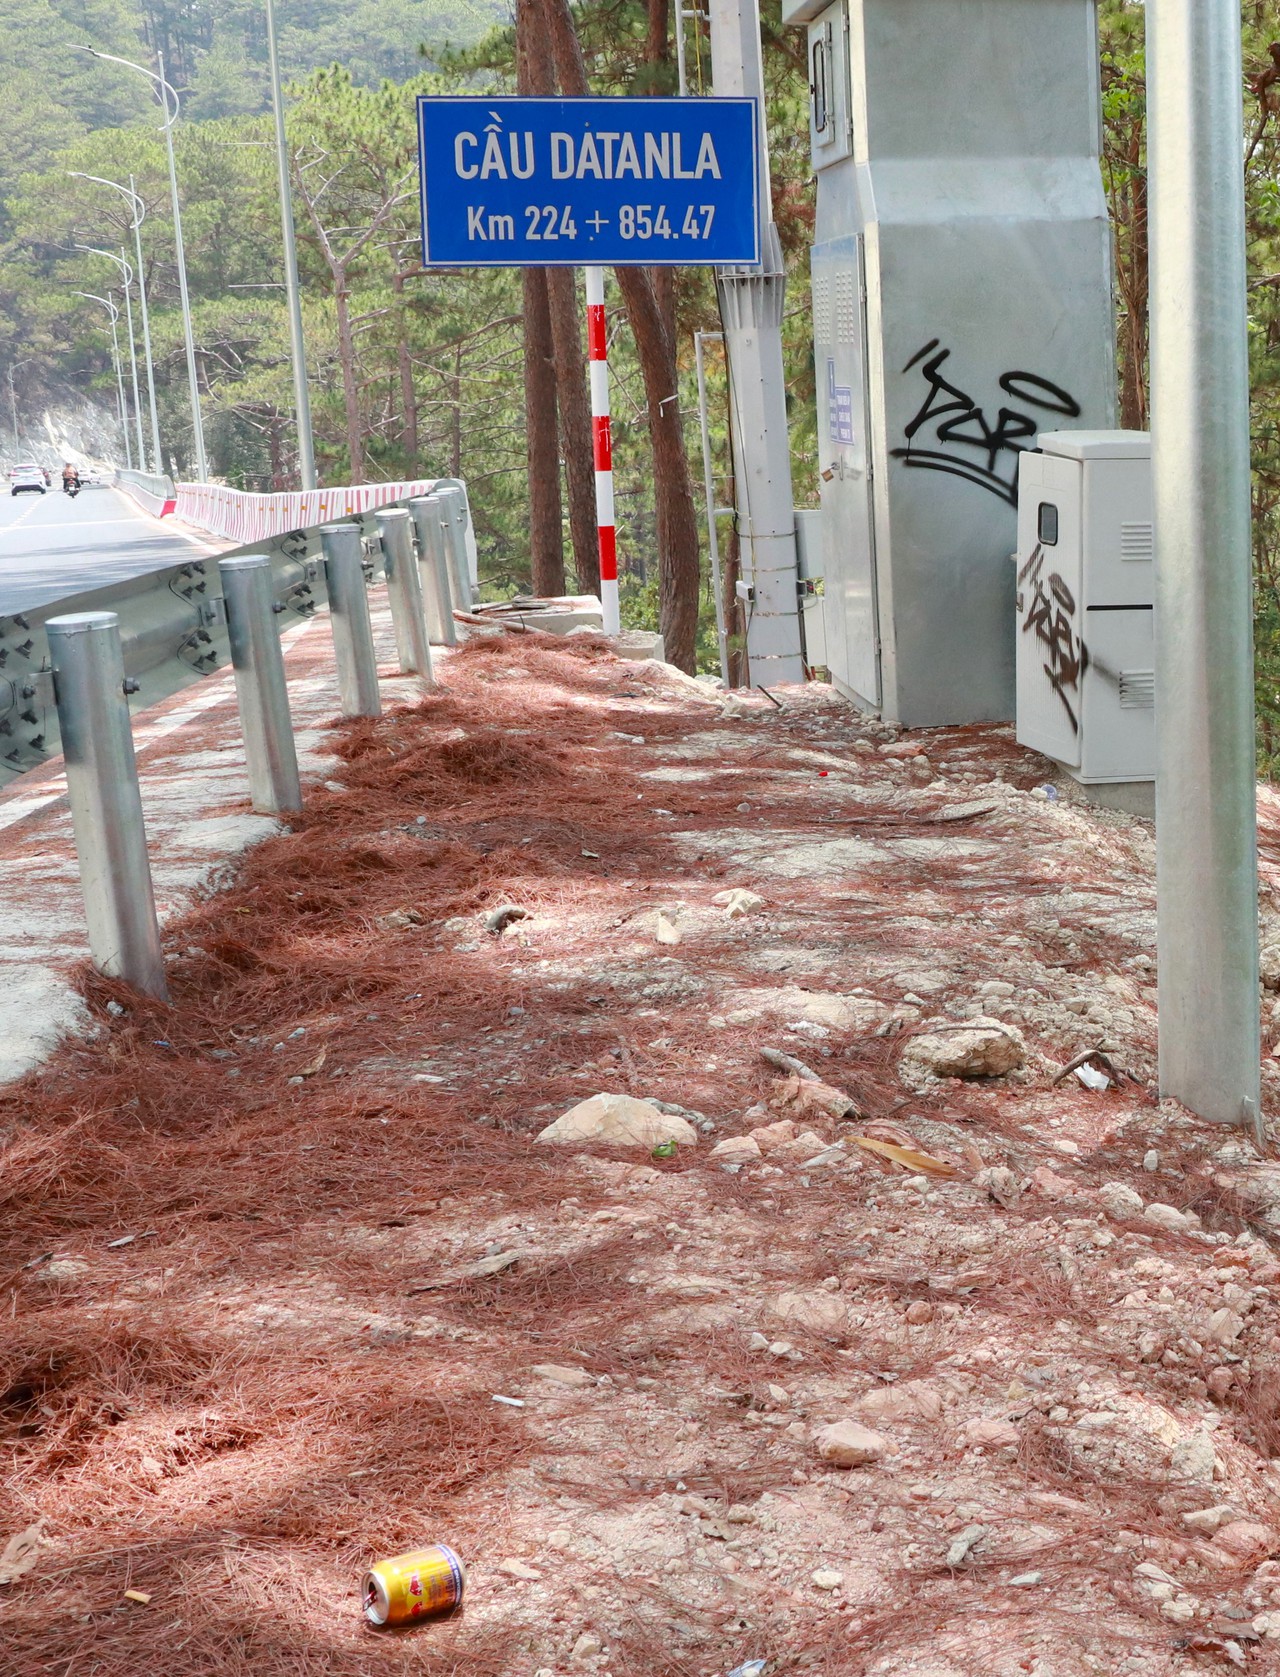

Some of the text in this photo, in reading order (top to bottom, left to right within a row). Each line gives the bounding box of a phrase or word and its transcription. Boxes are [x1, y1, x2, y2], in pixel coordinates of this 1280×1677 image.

[454, 111, 722, 180] CẦU DATANLA
[467, 206, 514, 241] Km
[525, 205, 577, 240] 224
[618, 205, 715, 240] 854.47
